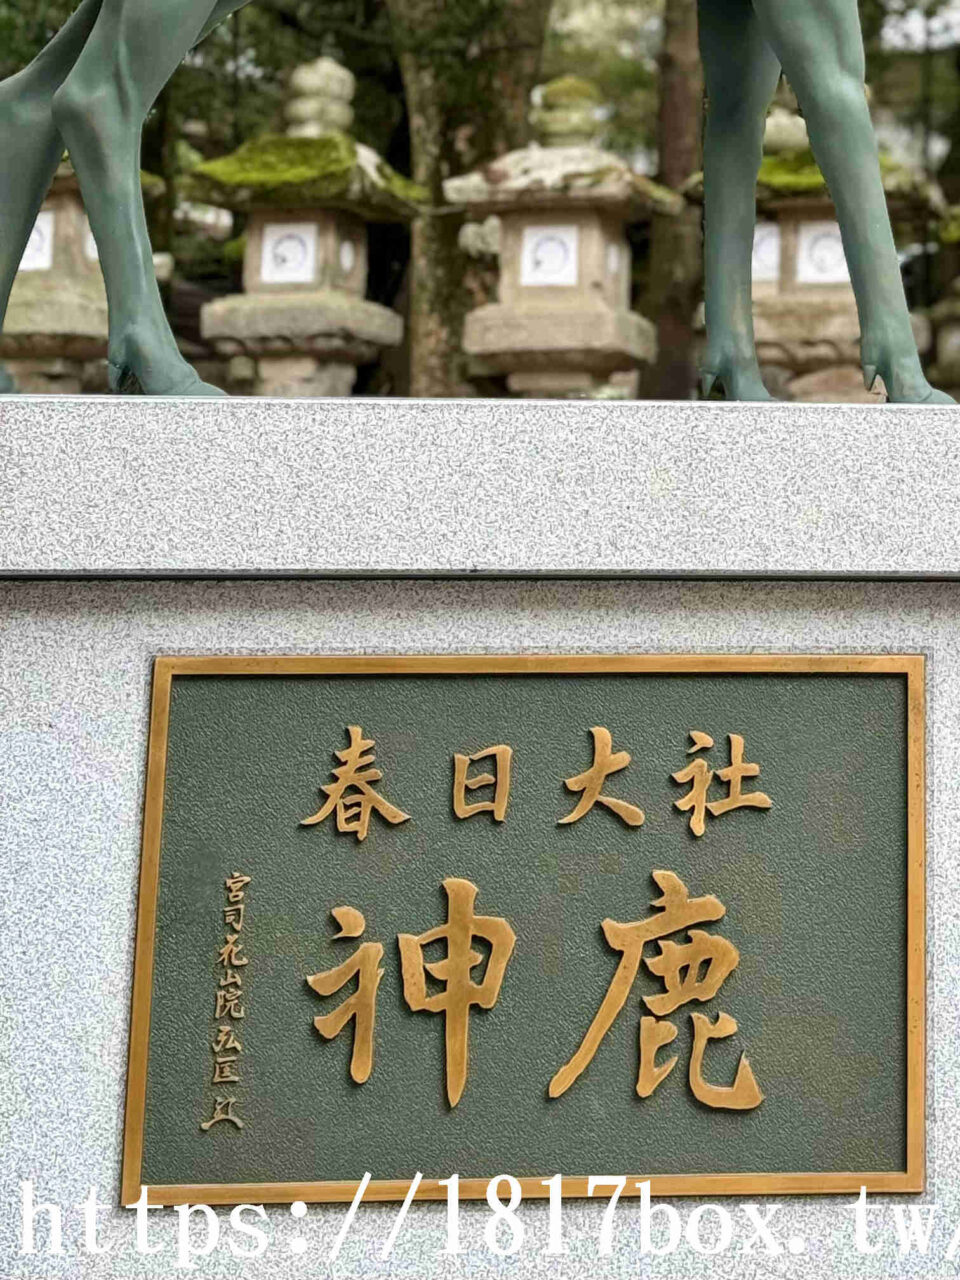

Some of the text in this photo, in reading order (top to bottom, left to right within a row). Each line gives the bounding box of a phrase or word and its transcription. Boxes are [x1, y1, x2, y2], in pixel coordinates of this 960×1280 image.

[300, 725, 772, 841] 春日大社
[305, 869, 764, 1110] 神鹿
